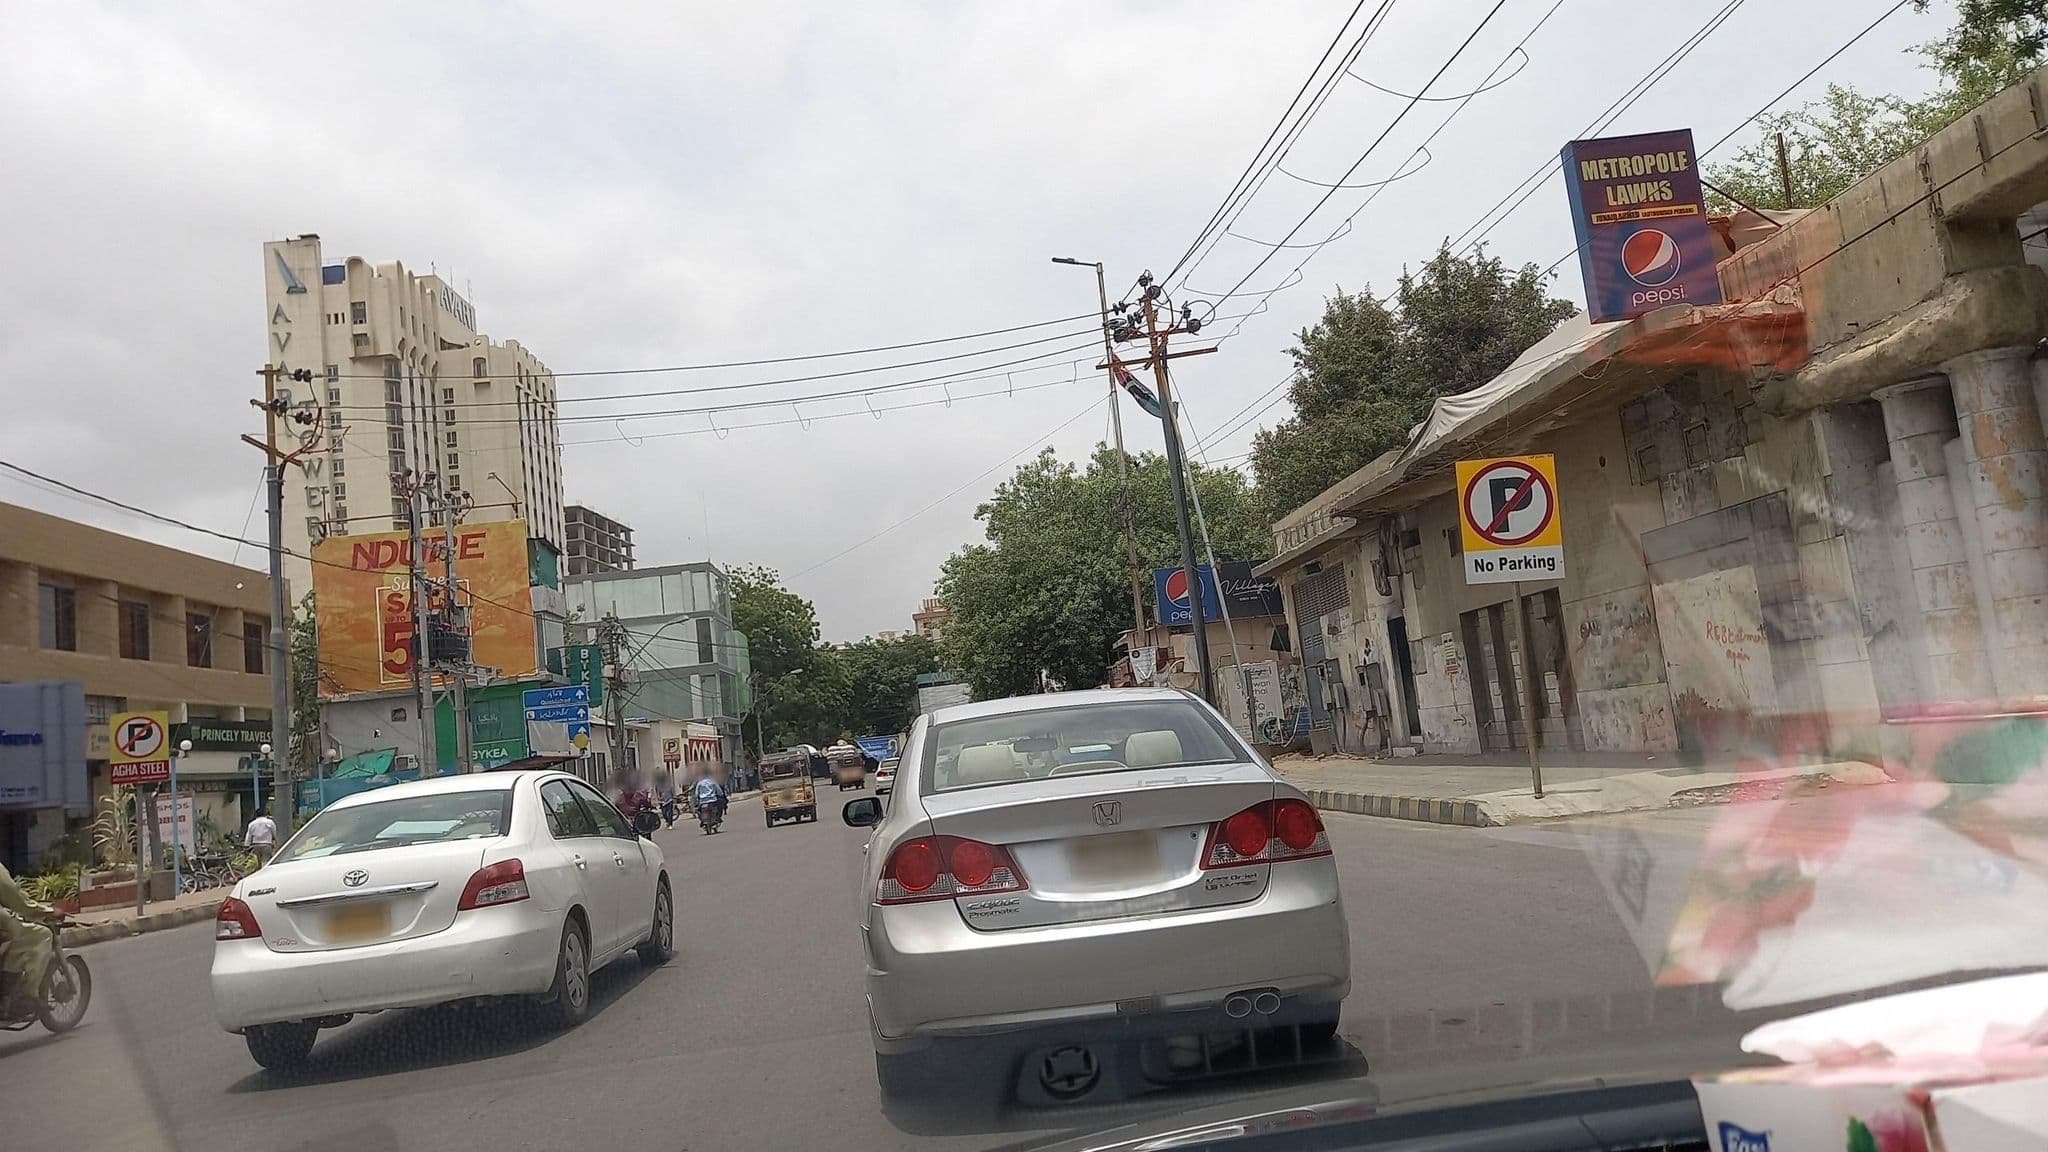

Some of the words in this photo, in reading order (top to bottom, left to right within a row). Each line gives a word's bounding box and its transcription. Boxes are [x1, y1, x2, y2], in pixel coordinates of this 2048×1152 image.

[1581, 150, 1688, 181] METROPOLE
[1606, 180, 1673, 206] LAWNS
[1632, 284, 1685, 307] pepsi
[1474, 558, 1494, 573] No
[1499, 554, 1556, 571] Parking
[200, 728, 240, 742] PRINCELY
[241, 730, 272, 743] TRAVELS
[112, 763, 139, 777] AGHA
[140, 761, 168, 775] STEEL
